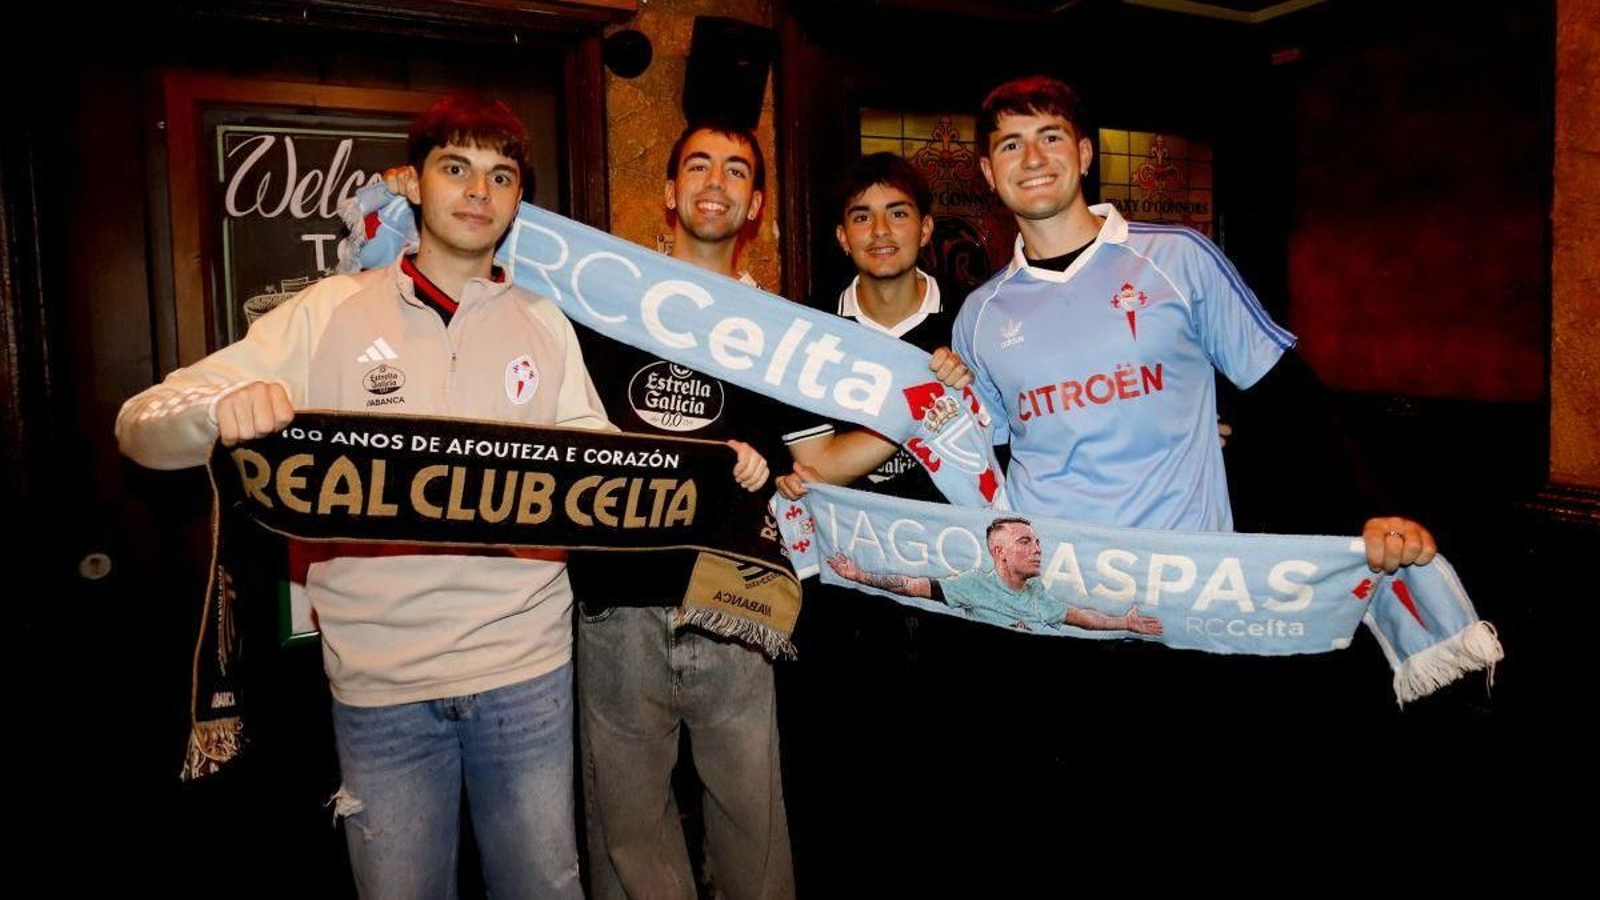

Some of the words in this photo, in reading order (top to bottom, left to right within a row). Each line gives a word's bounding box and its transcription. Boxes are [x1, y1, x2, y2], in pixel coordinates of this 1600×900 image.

[226, 135, 384, 218] Welc
[509, 216, 893, 417] RCCelta
[645, 371, 711, 398] Estrella
[645, 390, 705, 415] Galicia
[1018, 363, 1164, 422] CITROËN
[331, 432, 403, 450] ANOS
[411, 435, 440, 453] DE
[446, 438, 559, 462] AFOUTEZA
[566, 447, 577, 463] E
[583, 448, 680, 469] CORAZÓN
[231, 448, 398, 517] REAL
[410, 463, 556, 524] CLUB
[565, 475, 698, 529] CELTA
[828, 503, 982, 575] IAGO
[1042, 541, 1320, 614] ASPAS
[1185, 616, 1305, 638] RCCelta
